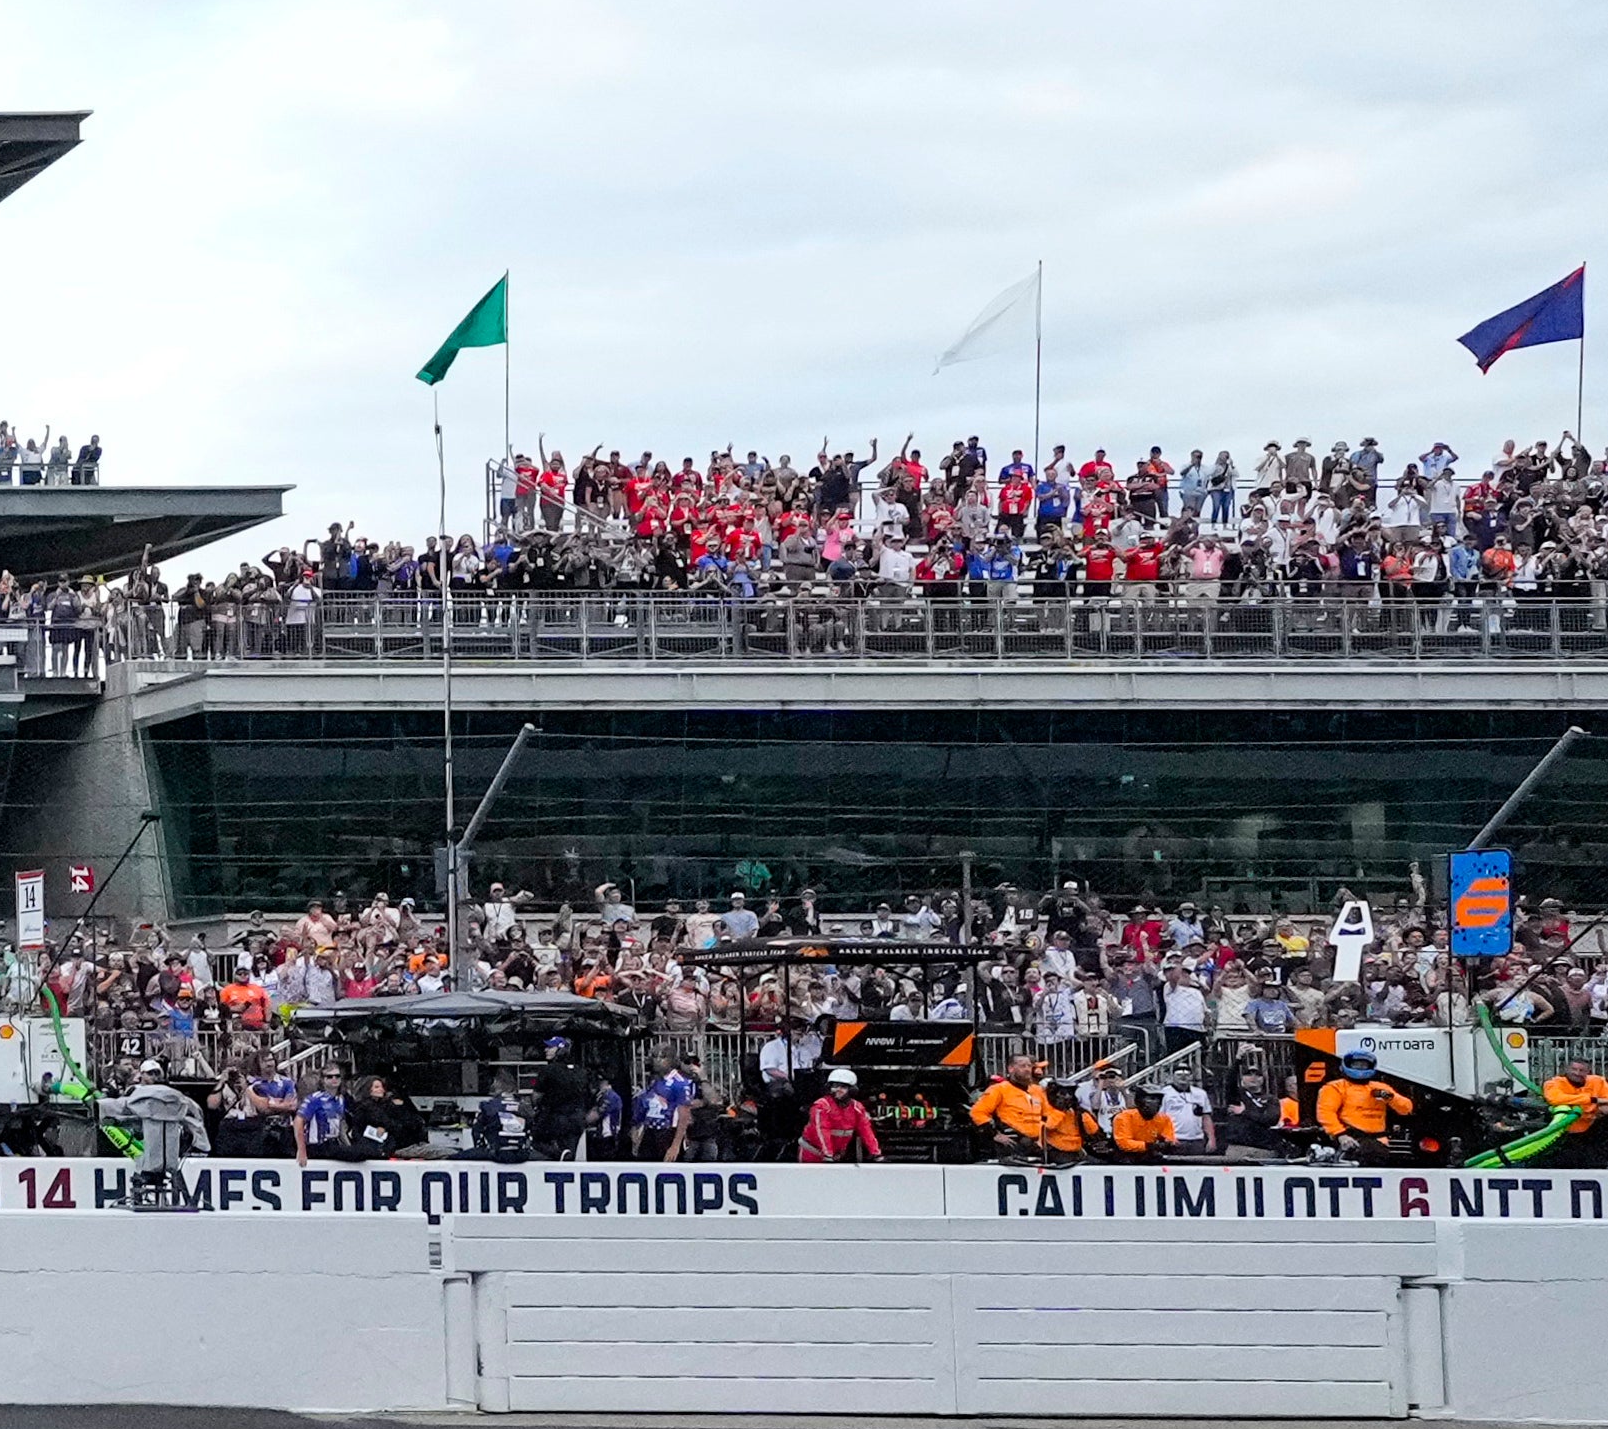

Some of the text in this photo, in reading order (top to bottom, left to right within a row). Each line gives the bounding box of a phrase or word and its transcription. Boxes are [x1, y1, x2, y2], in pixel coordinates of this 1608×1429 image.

[25, 884, 36, 909] 14
[119, 1037, 142, 1056] 42
[1378, 1040, 1402, 1051] NTT
[17, 1167, 76, 1209] 14
[301, 1169, 401, 1212] FOR
[544, 1171, 759, 1216] TROOPS
[1400, 1177, 1430, 1219] 6
[1449, 1177, 1554, 1219] NTT
